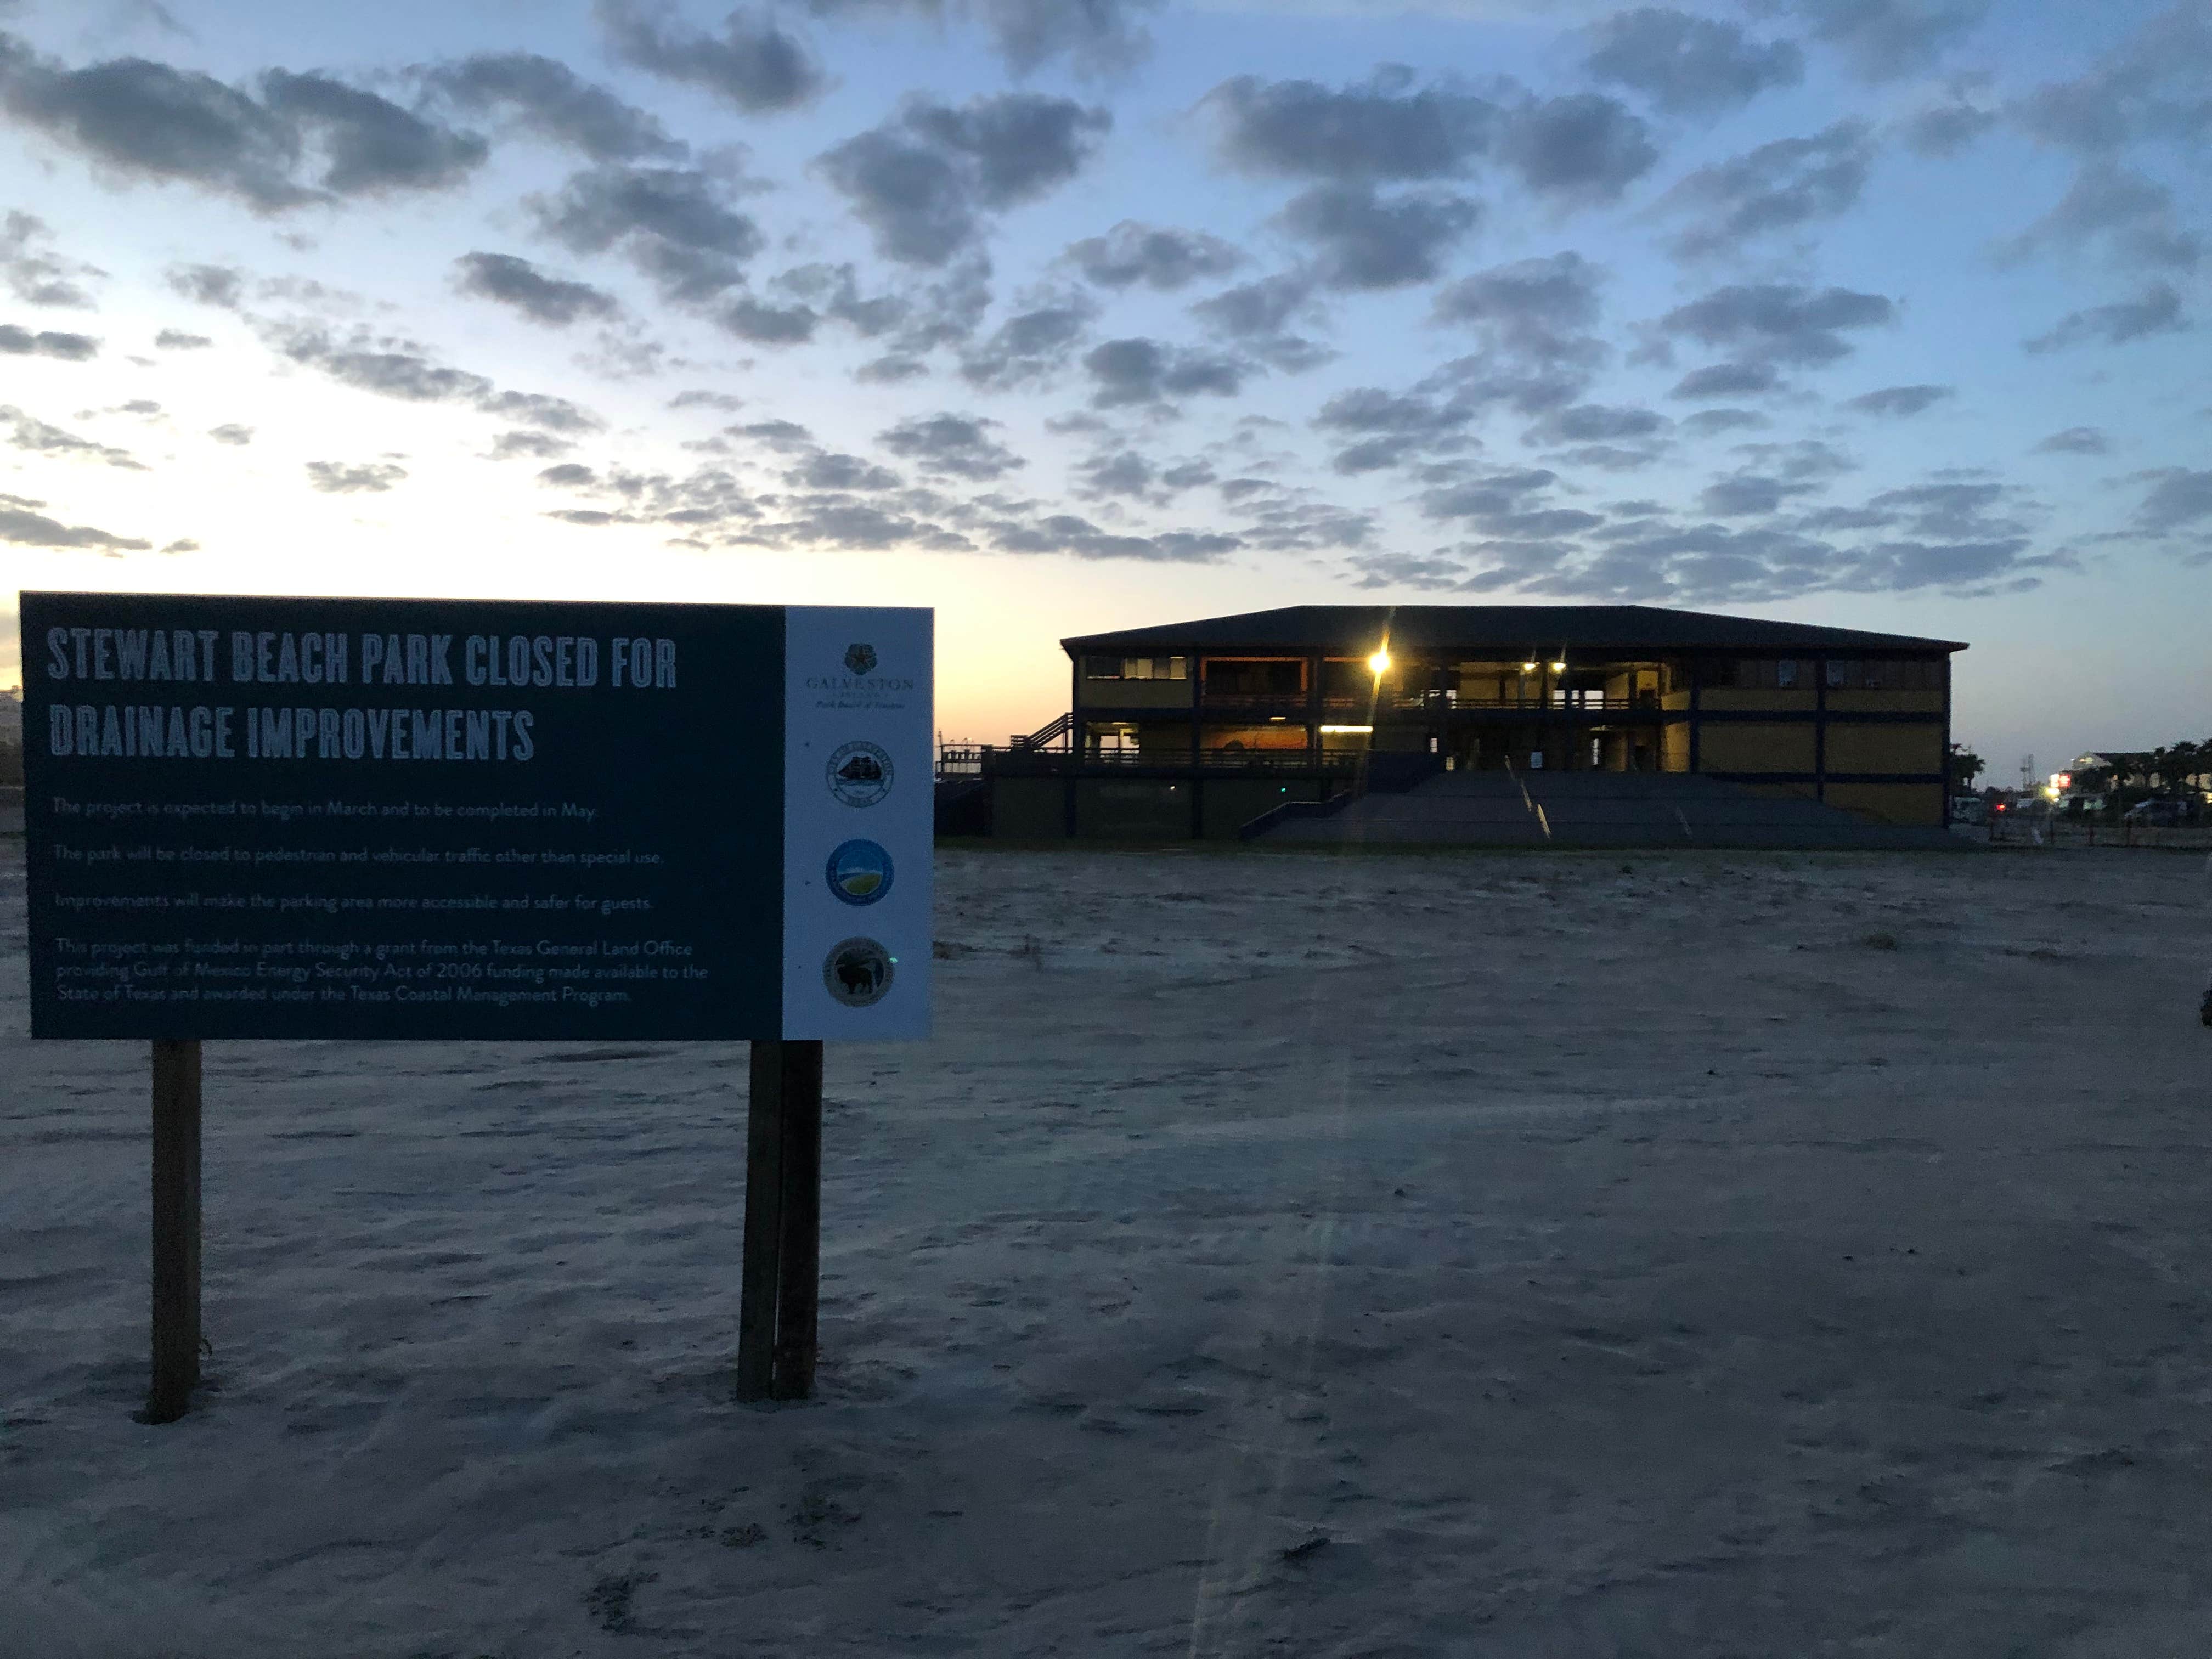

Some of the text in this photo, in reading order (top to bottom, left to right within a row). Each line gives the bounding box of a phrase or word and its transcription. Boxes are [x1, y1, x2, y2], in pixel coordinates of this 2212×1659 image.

[47, 625, 676, 690] STEWART BEACH PARK CLOSED FOR
[50, 705, 534, 761] DRAINAGE IMPROVEMENTS
[53, 797, 80, 813] The
[86, 802, 142, 819] project
[163, 801, 236, 820] expected
[241, 803, 256, 814] to
[262, 800, 303, 823] begin
[309, 804, 322, 815] in
[326, 801, 376, 815] March
[381, 802, 409, 815] and
[415, 804, 430, 815] to
[435, 802, 453, 816] be
[457, 802, 539, 821] completed
[543, 804, 556, 816] in
[54, 844, 82, 860] The
[87, 845, 120, 865] park
[127, 845, 151, 860] will
[156, 847, 175, 861] be
[181, 846, 229, 861] closed
[234, 849, 250, 861] to
[255, 847, 335, 866] pedestrian
[340, 847, 368, 861] and
[373, 847, 439, 862] vehicular
[446, 847, 491, 862] traffic
[496, 848, 535, 863] other
[541, 849, 575, 863] than
[580, 849, 630, 867] special
[55, 893, 169, 912] Improvements
[174, 892, 198, 906] will
[203, 894, 246, 907] make
[251, 893, 275, 907] the
[281, 894, 338, 913] parking
[342, 897, 373, 909] area
[378, 897, 417, 909] more
[422, 894, 498, 909] accessible
[502, 894, 529, 909] and
[534, 894, 569, 909] safer
[575, 894, 597, 909] for
[55, 938, 87, 953] This
[92, 942, 148, 958] project
[152, 943, 179, 953] was
[185, 938, 239, 953] funded
[262, 941, 294, 958] part
[298, 939, 360, 960] through
[364, 944, 371, 955] a
[376, 941, 415, 960] grant
[420, 940, 458, 955] from
[462, 940, 487, 955] the
[492, 940, 533, 955] Texas
[537, 940, 597, 956] General
[603, 940, 639, 956] Land
[644, 940, 693, 956] Office
[56, 961, 129, 983] providing
[134, 961, 168, 977] Gulf
[176, 961, 190, 977] of
[256, 962, 310, 983] Energy
[315, 961, 379, 982] Security
[384, 963, 413, 978] Act
[417, 962, 433, 978] of
[437, 963, 482, 978] 2006
[487, 963, 544, 984] funding
[549, 964, 590, 979] made
[595, 964, 658, 979] available
[663, 967, 678, 979] to
[683, 965, 708, 979] the
[57, 984, 99, 1000] State
[104, 984, 122, 1001] of
[124, 985, 166, 1001] Texas
[170, 987, 199, 1001] and
[202, 986, 267, 1001] awarded
[272, 986, 315, 1001] under
[321, 986, 346, 1001] the
[351, 985, 391, 1001] Texas
[395, 985, 452, 1001] Coastal
[456, 986, 557, 1007] Management
